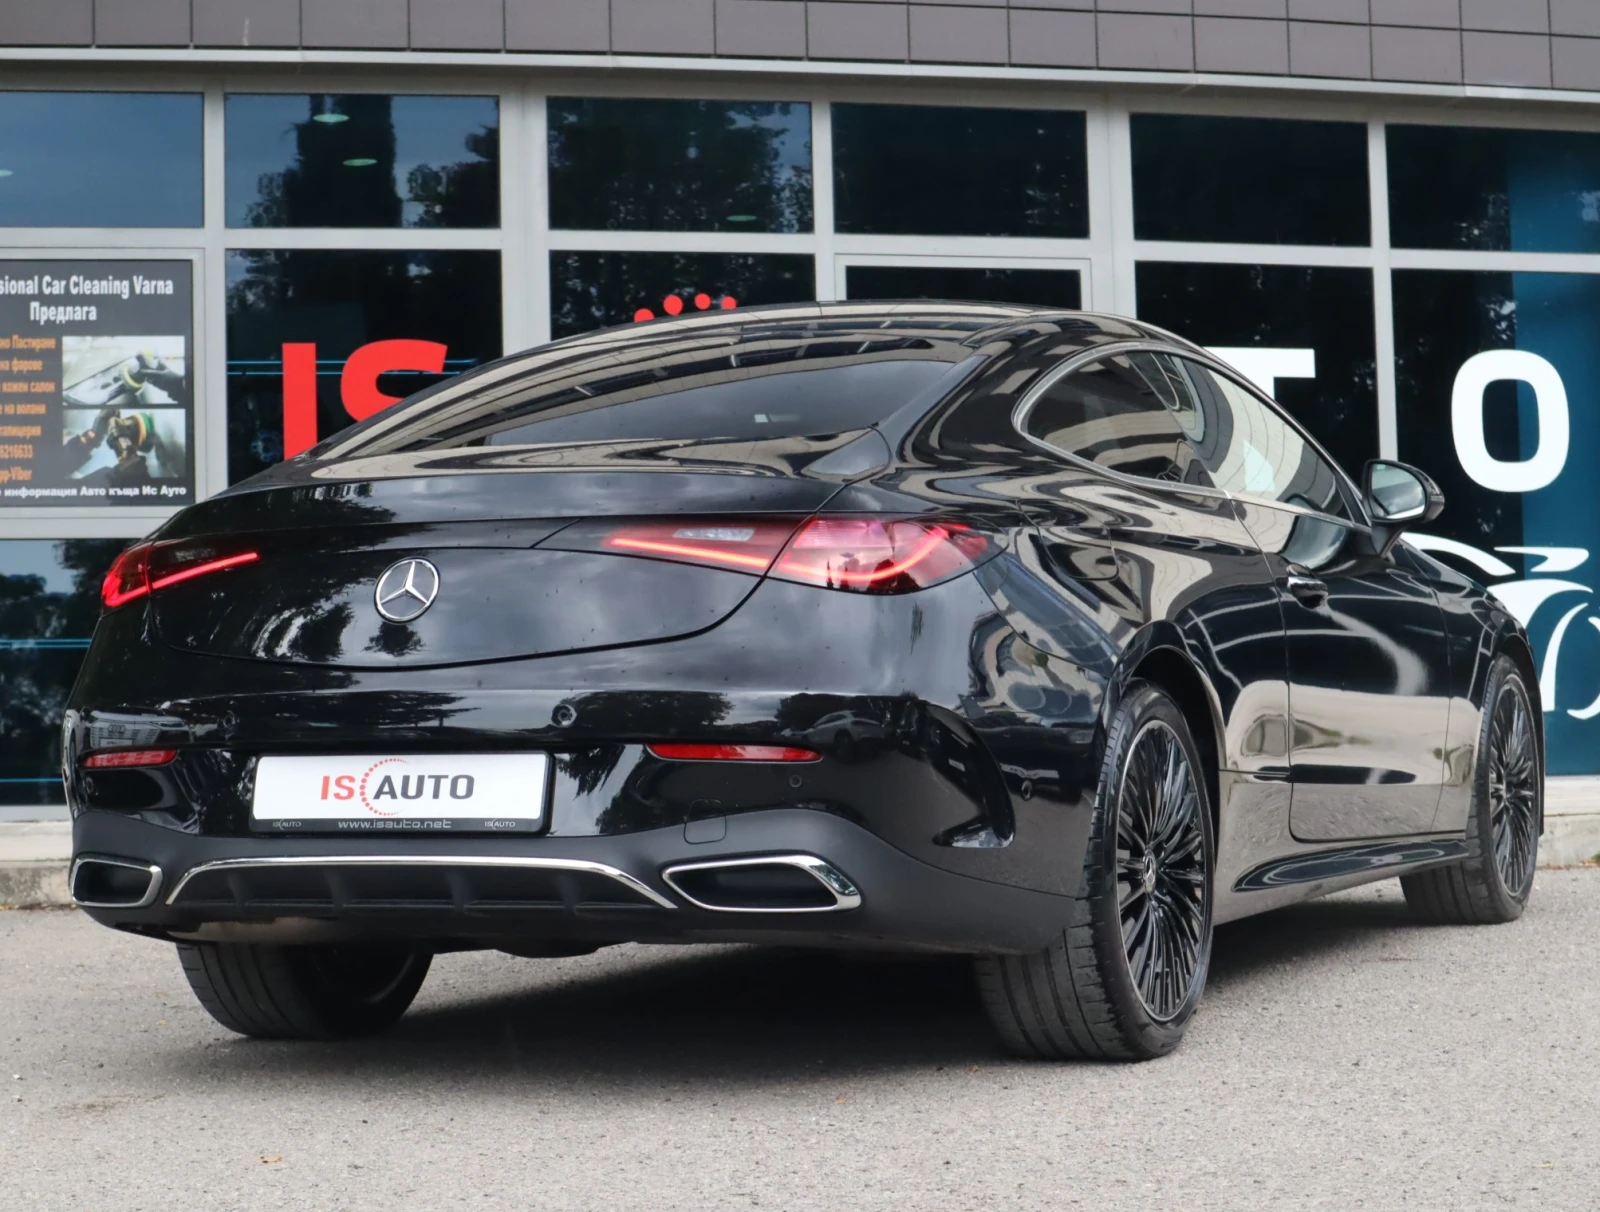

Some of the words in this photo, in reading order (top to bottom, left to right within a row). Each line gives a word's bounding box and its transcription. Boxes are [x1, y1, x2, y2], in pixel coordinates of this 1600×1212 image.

[42, 275, 67, 295] Car
[69, 275, 130, 300] Cleaning
[132, 275, 174, 295] Varna
[30, 301, 97, 325] Предлага
[4, 485, 77, 499] информация
[79, 486, 107, 497] Авто
[108, 487, 139, 498] къща
[142, 485, 158, 496] Ис
[160, 486, 187, 498] Ауто
[320, 775, 356, 801] IS
[373, 774, 475, 800] AUTO
[338, 819, 452, 830] www.isauto.net
